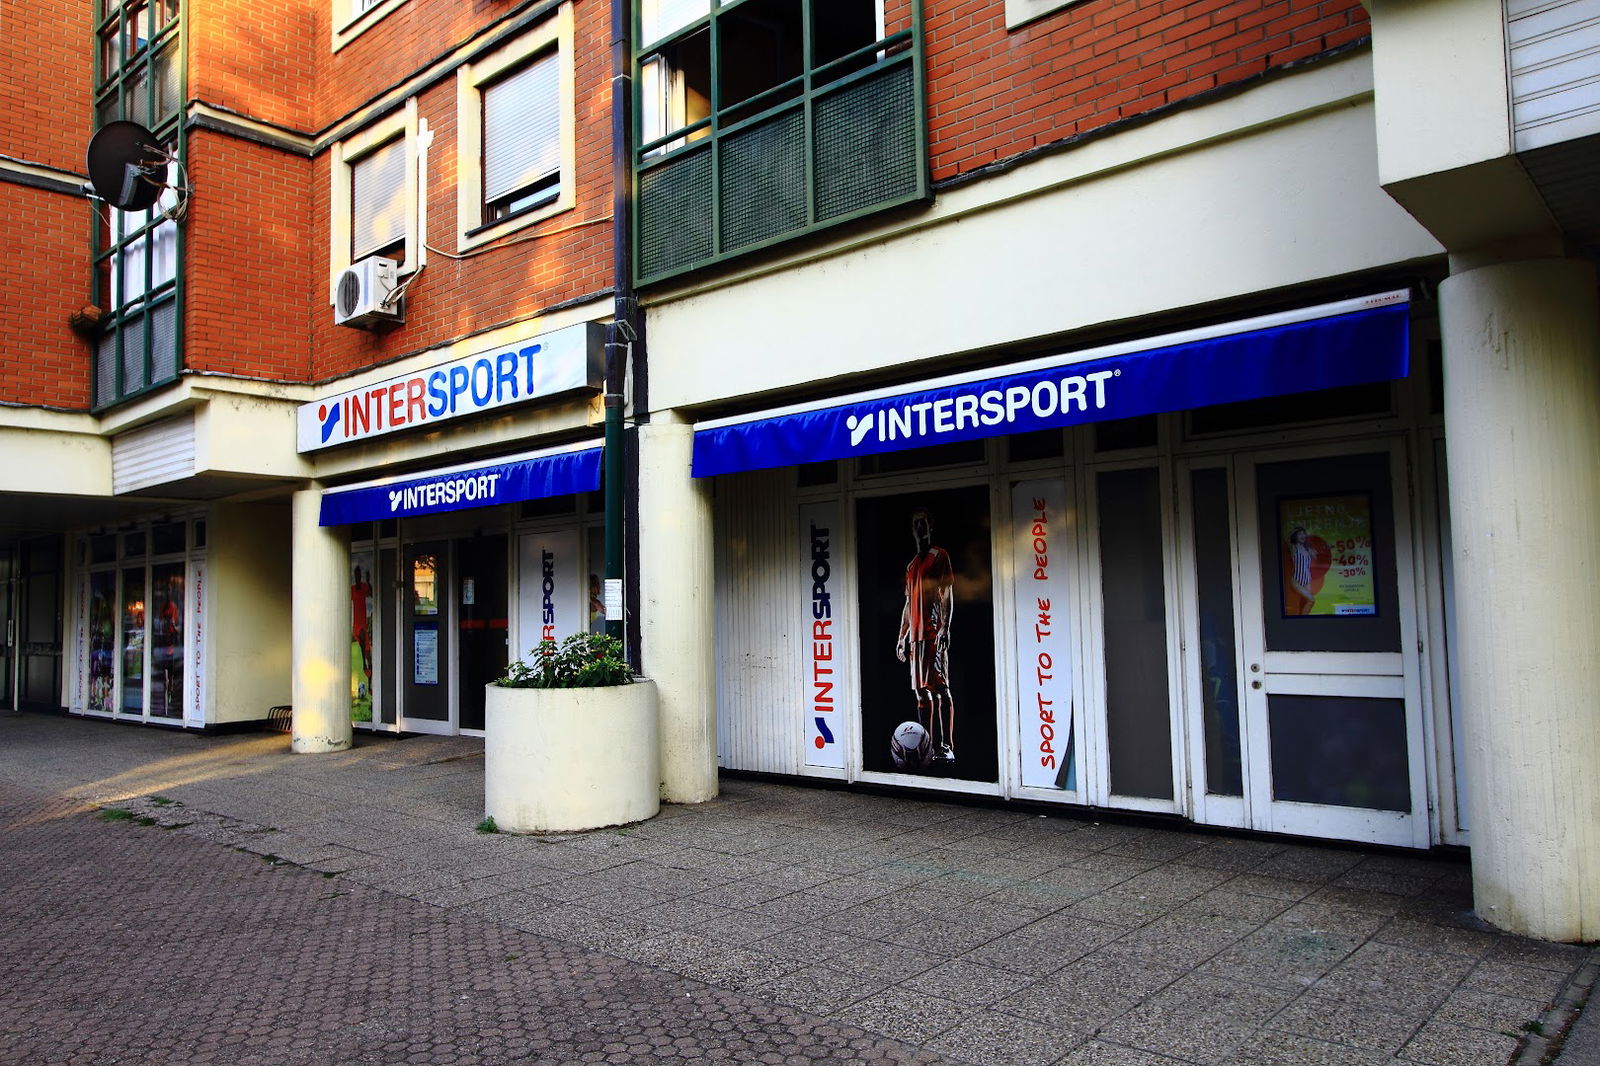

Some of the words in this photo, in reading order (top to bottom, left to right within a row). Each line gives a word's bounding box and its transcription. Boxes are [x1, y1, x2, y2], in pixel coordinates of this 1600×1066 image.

[344, 343, 542, 438] INTERSPORT
[877, 369, 1109, 442] INTERSPORT
[403, 474, 498, 510] INTERSPORT
[1031, 496, 1049, 580] PEOPLE
[811, 525, 833, 712] INTERSPORT
[1035, 597, 1051, 643] THE
[1036, 652, 1053, 687] TO
[1038, 692, 1056, 770] SPORT
